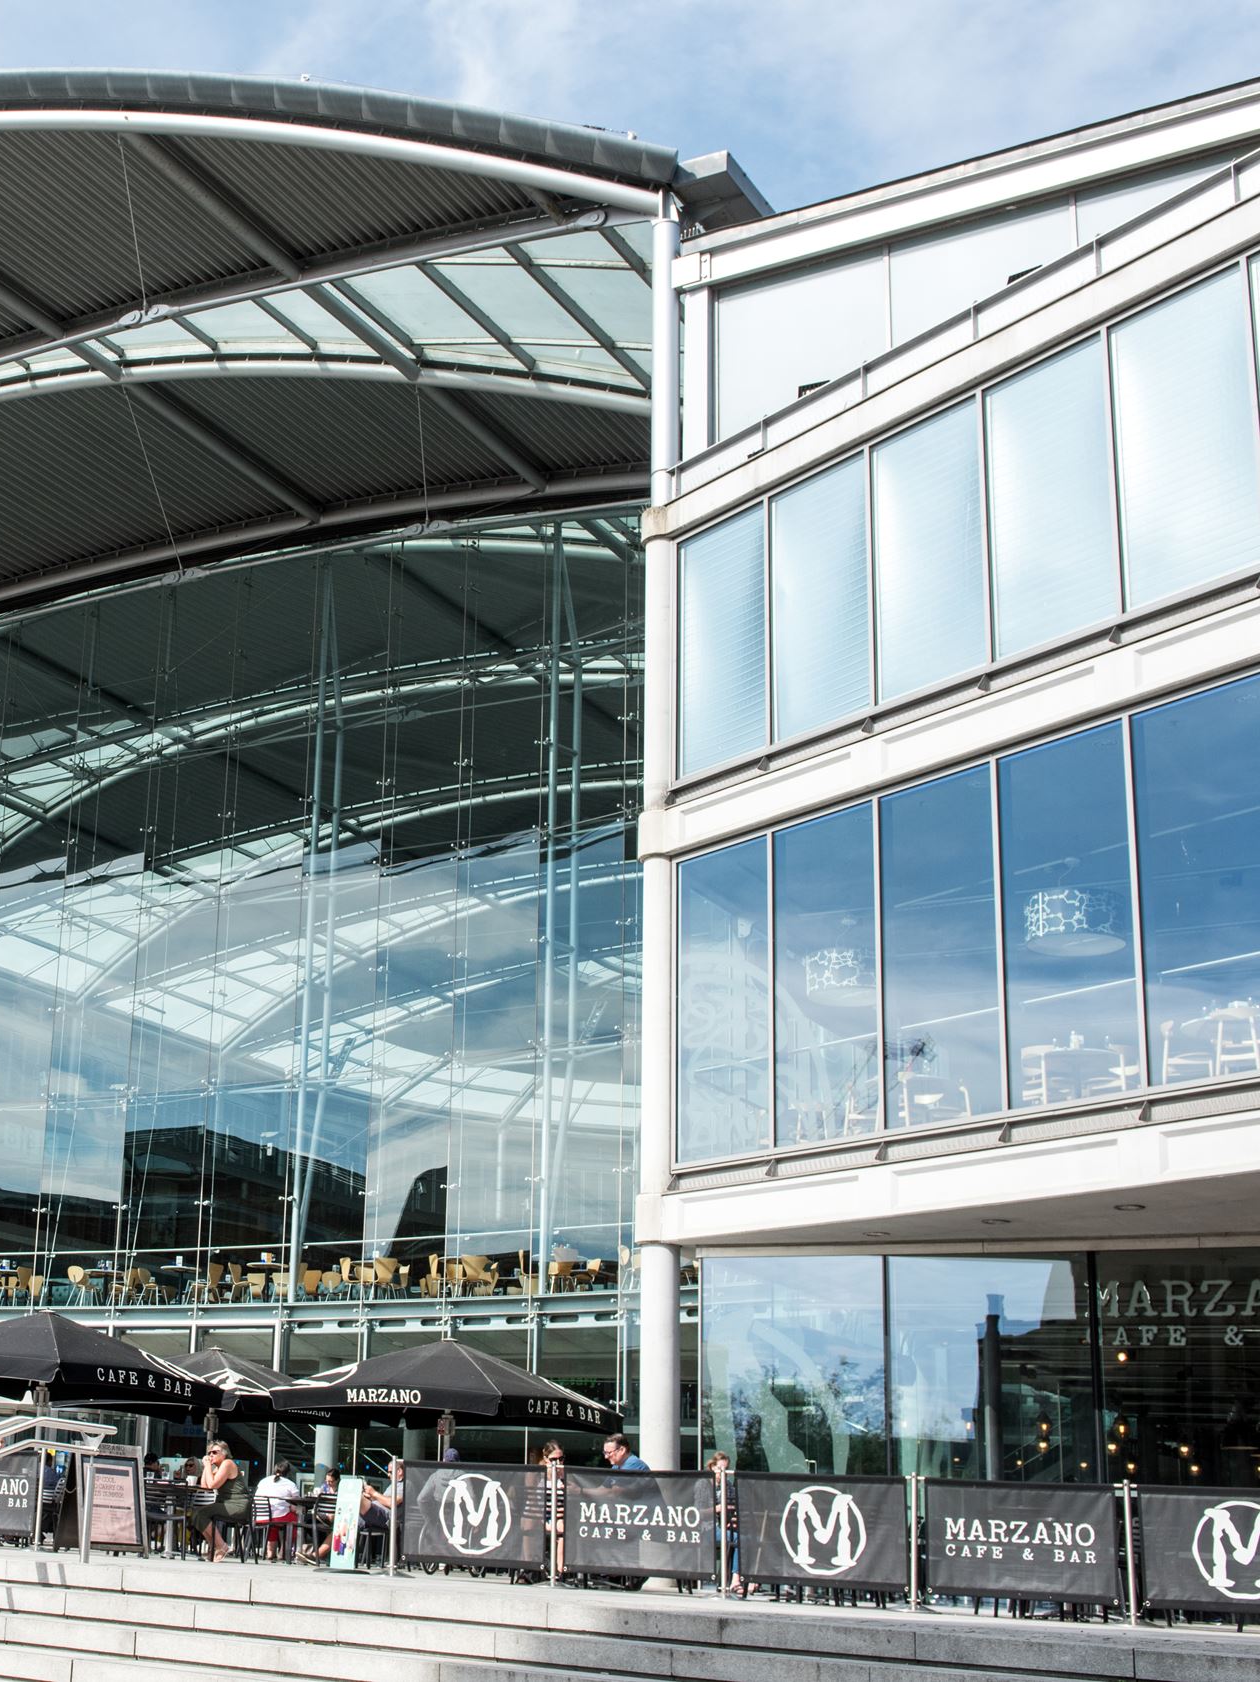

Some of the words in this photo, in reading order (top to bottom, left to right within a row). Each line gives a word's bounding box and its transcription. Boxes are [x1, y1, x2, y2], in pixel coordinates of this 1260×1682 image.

[1224, 1325, 1244, 1346] &
[97, 1368, 138, 1386] CAFE
[147, 1375, 156, 1389] &
[164, 1380, 192, 1397] BAR
[346, 1388, 421, 1404] MARZANO
[528, 1399, 559, 1416] CAFE
[566, 1404, 574, 1417] &
[579, 1406, 601, 1424] BAR
[8, 1498, 28, 1508] BAR
[448, 1480, 502, 1547] M
[580, 1502, 700, 1527] MARZANO
[580, 1526, 626, 1540] CAFE
[642, 1530, 651, 1541] &
[667, 1531, 700, 1543] BAR
[790, 1493, 856, 1566] M
[945, 1517, 1096, 1547] MARZANO
[945, 1544, 1003, 1559] CAFE
[1022, 1548, 1034, 1561] &
[1053, 1549, 1097, 1564] BAR
